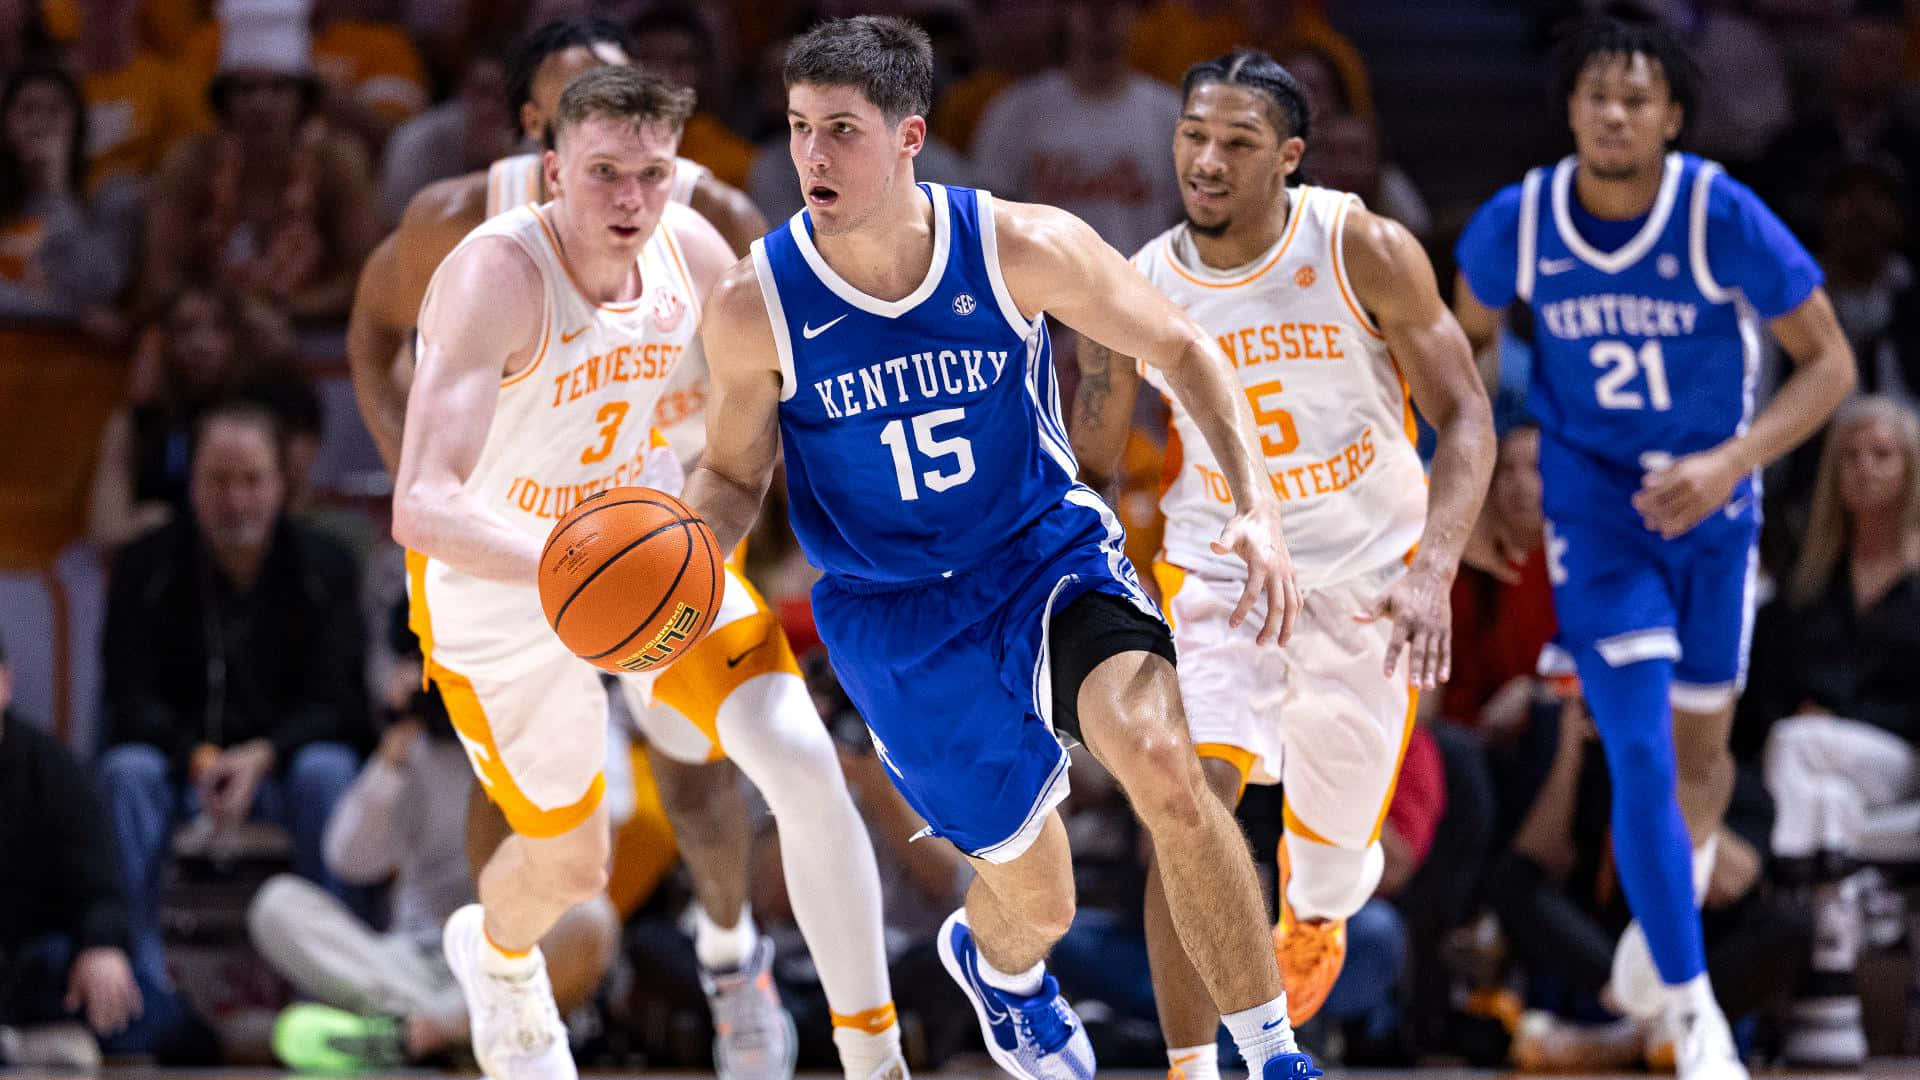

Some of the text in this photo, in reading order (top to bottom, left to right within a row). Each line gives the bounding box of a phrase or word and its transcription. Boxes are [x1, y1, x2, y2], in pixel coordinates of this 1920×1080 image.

[954, 294, 976, 315] SEC
[1543, 293, 1697, 340] KENTUCKY
[1217, 323, 1345, 369] NESSEE
[1589, 337, 1672, 411] 21
[814, 350, 1008, 419] KENTUCKY
[580, 401, 630, 465] 3
[1244, 380, 1300, 457] 5
[506, 438, 644, 520] OLUNTES
[879, 407, 977, 501] 15
[1193, 427, 1376, 505] ONTEERS
[615, 602, 685, 665] CHAMPION
[621, 605, 701, 671] ELITE
